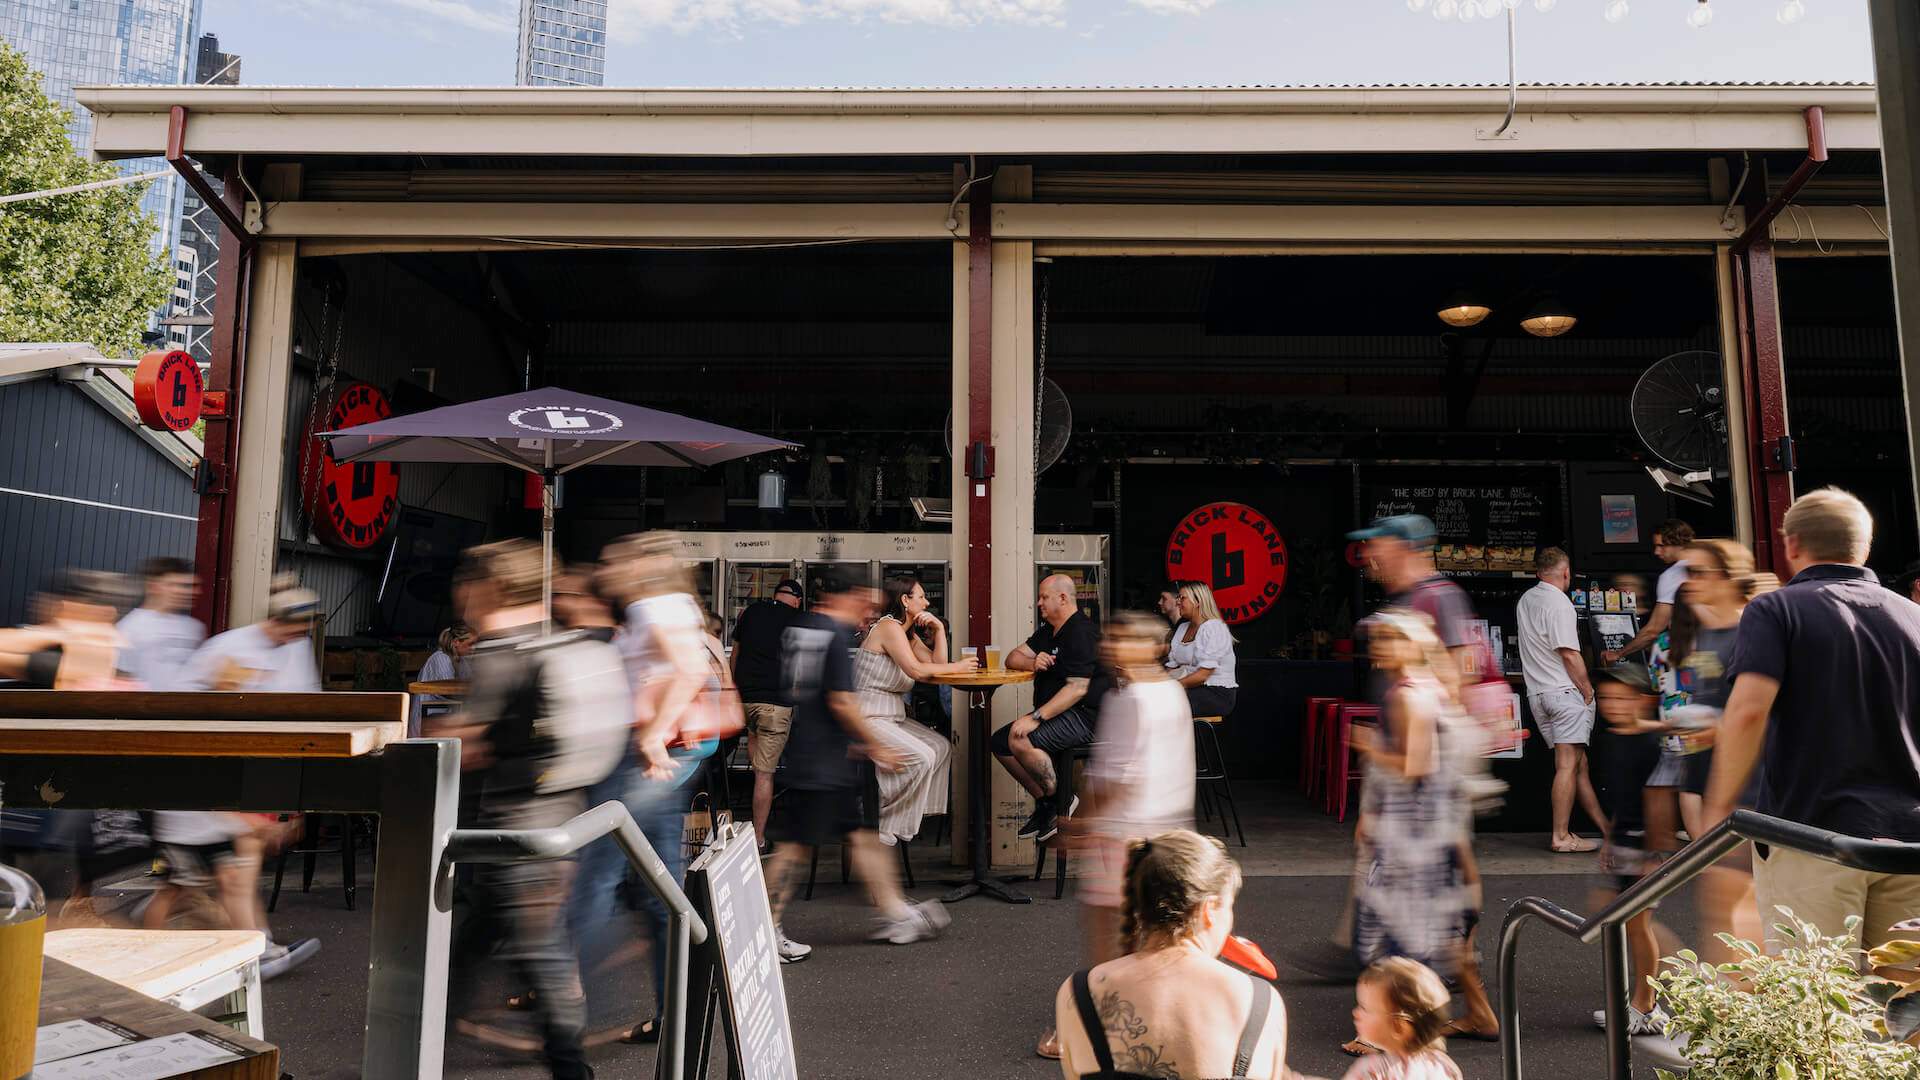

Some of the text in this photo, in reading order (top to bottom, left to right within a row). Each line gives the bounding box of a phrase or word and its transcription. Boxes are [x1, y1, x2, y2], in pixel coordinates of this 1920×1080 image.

[159, 354, 201, 393] BRICK LANE
[165, 411, 190, 428] SHED
[326, 480, 394, 542] BREWING
[1453, 488, 1475, 498] BRICK
[1481, 488, 1505, 498] LANE
[1170, 507, 1284, 566] BRICK LANE
[1220, 580, 1280, 621] WING
